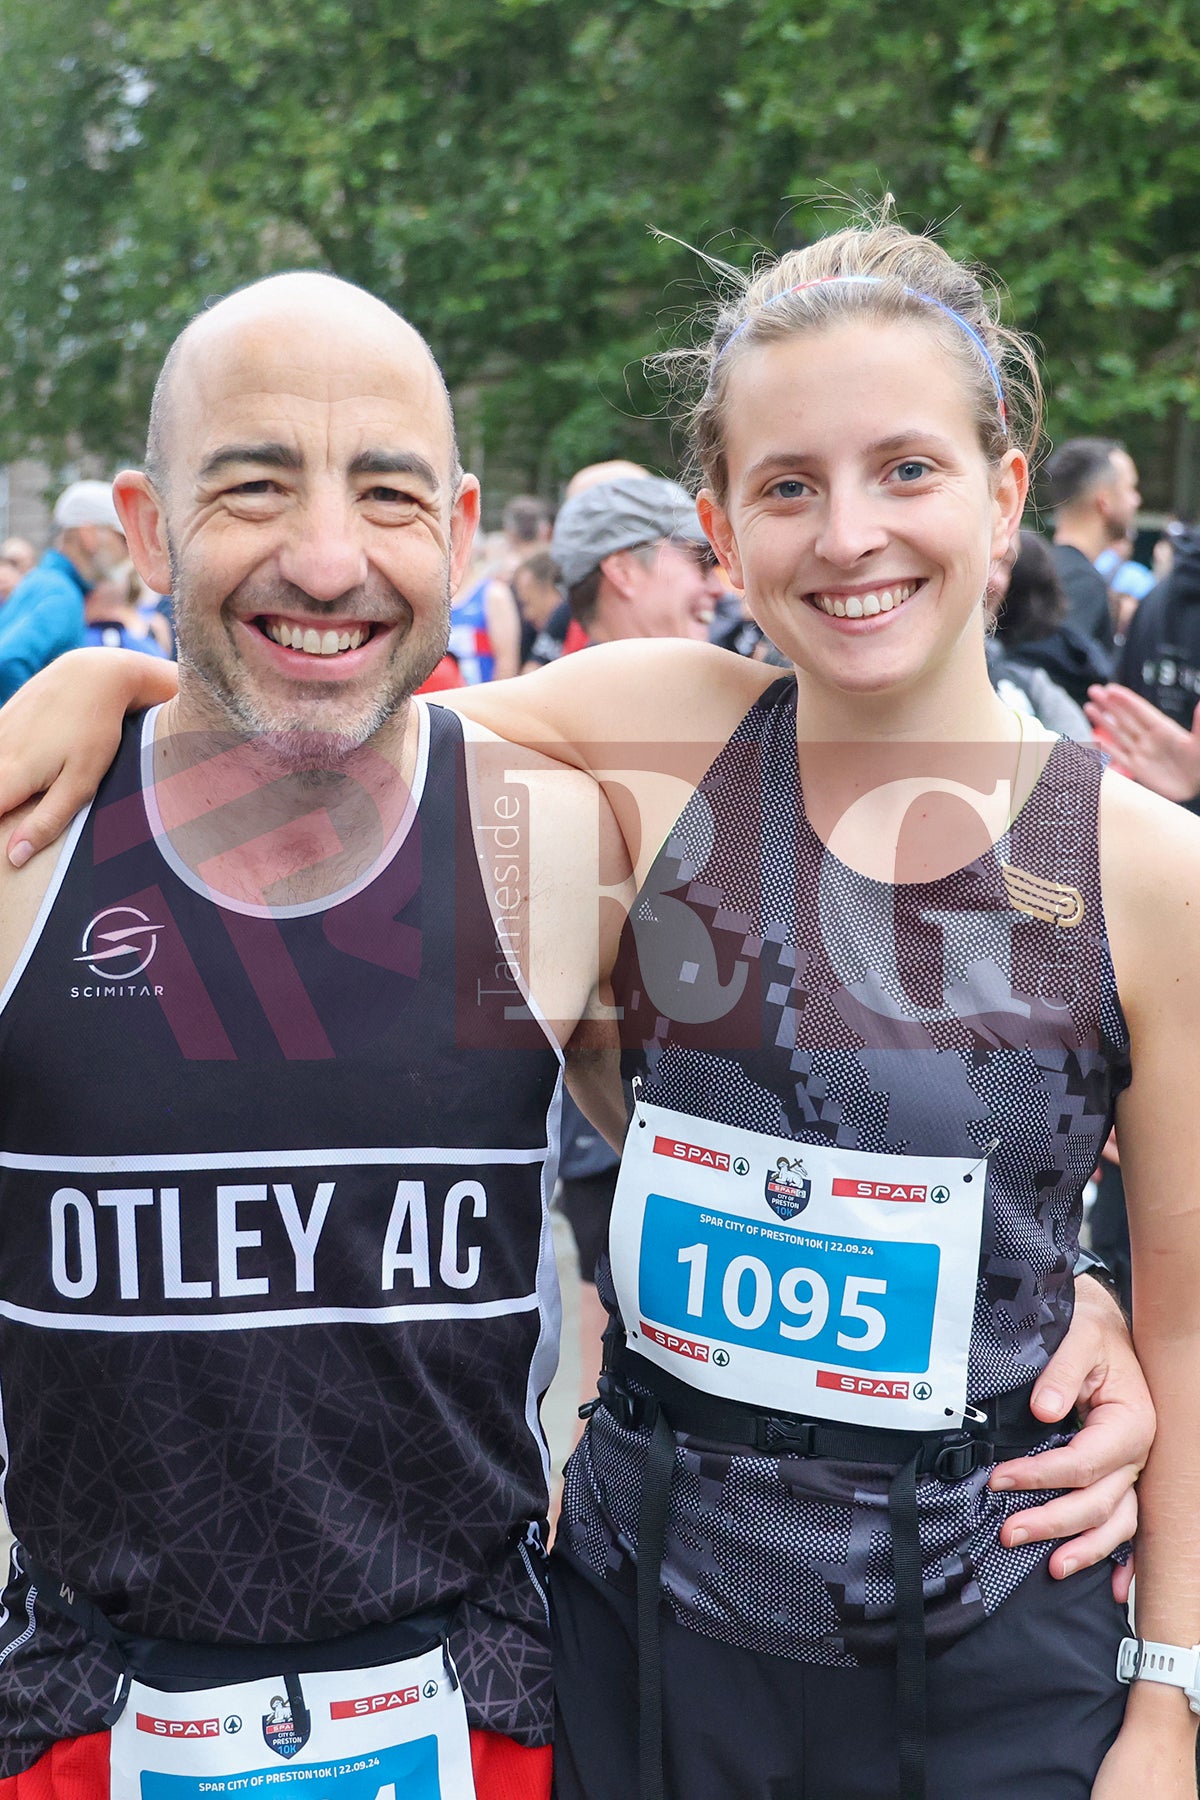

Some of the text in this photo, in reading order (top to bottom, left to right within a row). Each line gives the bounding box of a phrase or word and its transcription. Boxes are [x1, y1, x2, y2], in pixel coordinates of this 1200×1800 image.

[71, 985, 165, 997] SCIMITAR
[673, 1143, 729, 1169] SPAR
[775, 1185, 796, 1195] SPAR
[857, 1182, 926, 1202] SPAR
[772, 1198, 799, 1209] PRESTON
[776, 1206, 793, 1217] 10K
[50, 1180, 487, 1300] OTLEY AC
[699, 1213, 724, 1228] SPAR
[724, 1218, 745, 1233] CITY
[746, 1223, 759, 1236] OF
[830, 1241, 875, 1256] 22.09.24
[677, 1242, 887, 1352] 1095
[654, 1332, 709, 1360] SPAR
[840, 1377, 909, 1396] SPAR
[354, 1688, 419, 1714] SPAR
[154, 1721, 219, 1736] SPAR
[272, 1736, 302, 1745] PRESTON
[278, 1744, 297, 1754] 10K
[198, 1781, 226, 1792] SPAR
[227, 1779, 249, 1791] CITY
[251, 1776, 264, 1787] OF
[339, 1757, 380, 1774] 22.09.24
